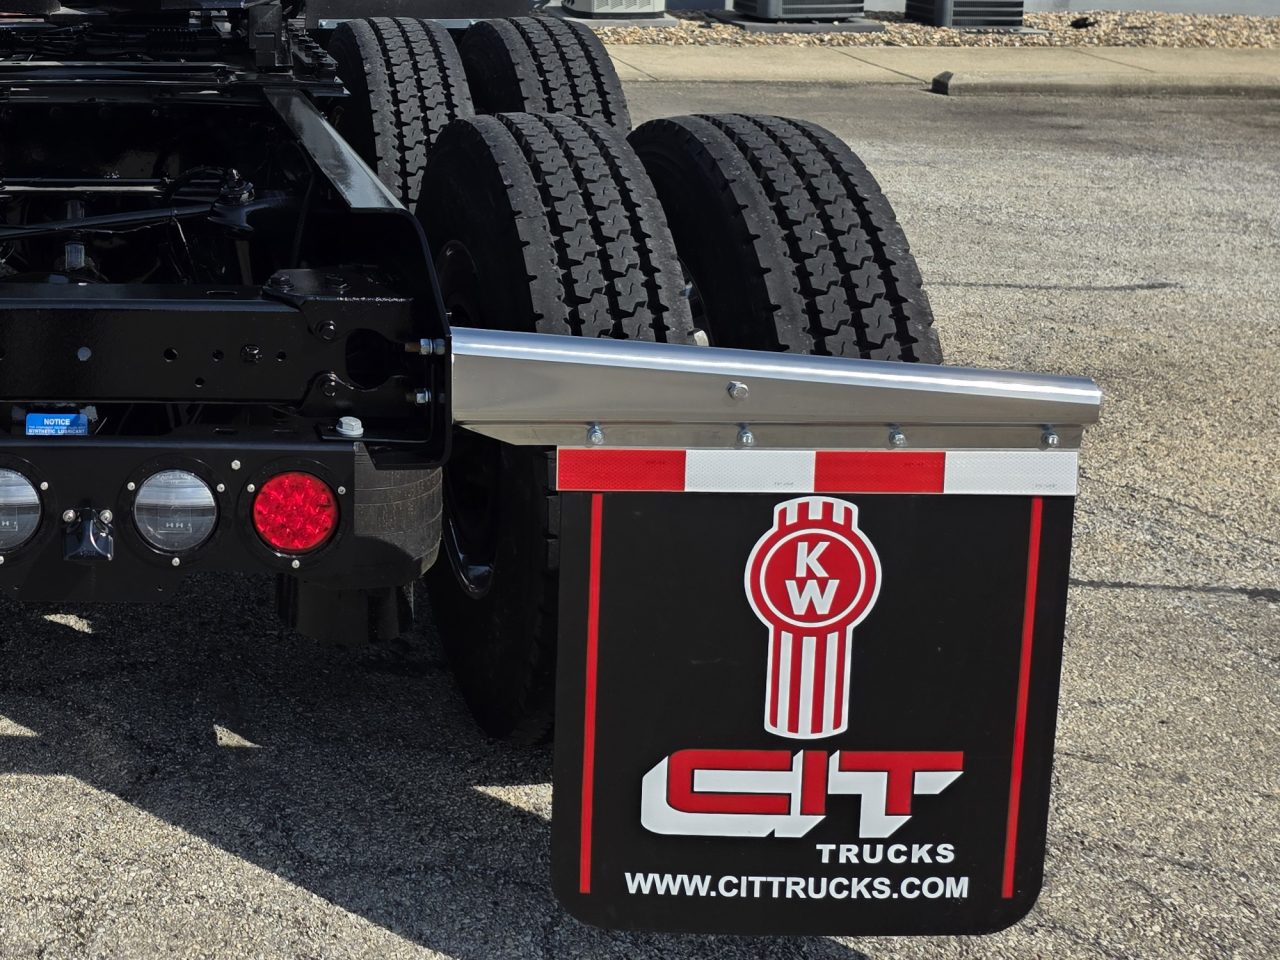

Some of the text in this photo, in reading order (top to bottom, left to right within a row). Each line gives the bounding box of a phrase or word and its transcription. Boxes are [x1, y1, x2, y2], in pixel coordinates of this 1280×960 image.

[43, 418, 71, 426] NOTICE
[662, 748, 964, 817] CIT
[816, 842, 956, 864] TRUCKS
[624, 872, 969, 899] WWW.CITTRUCKS.COM
